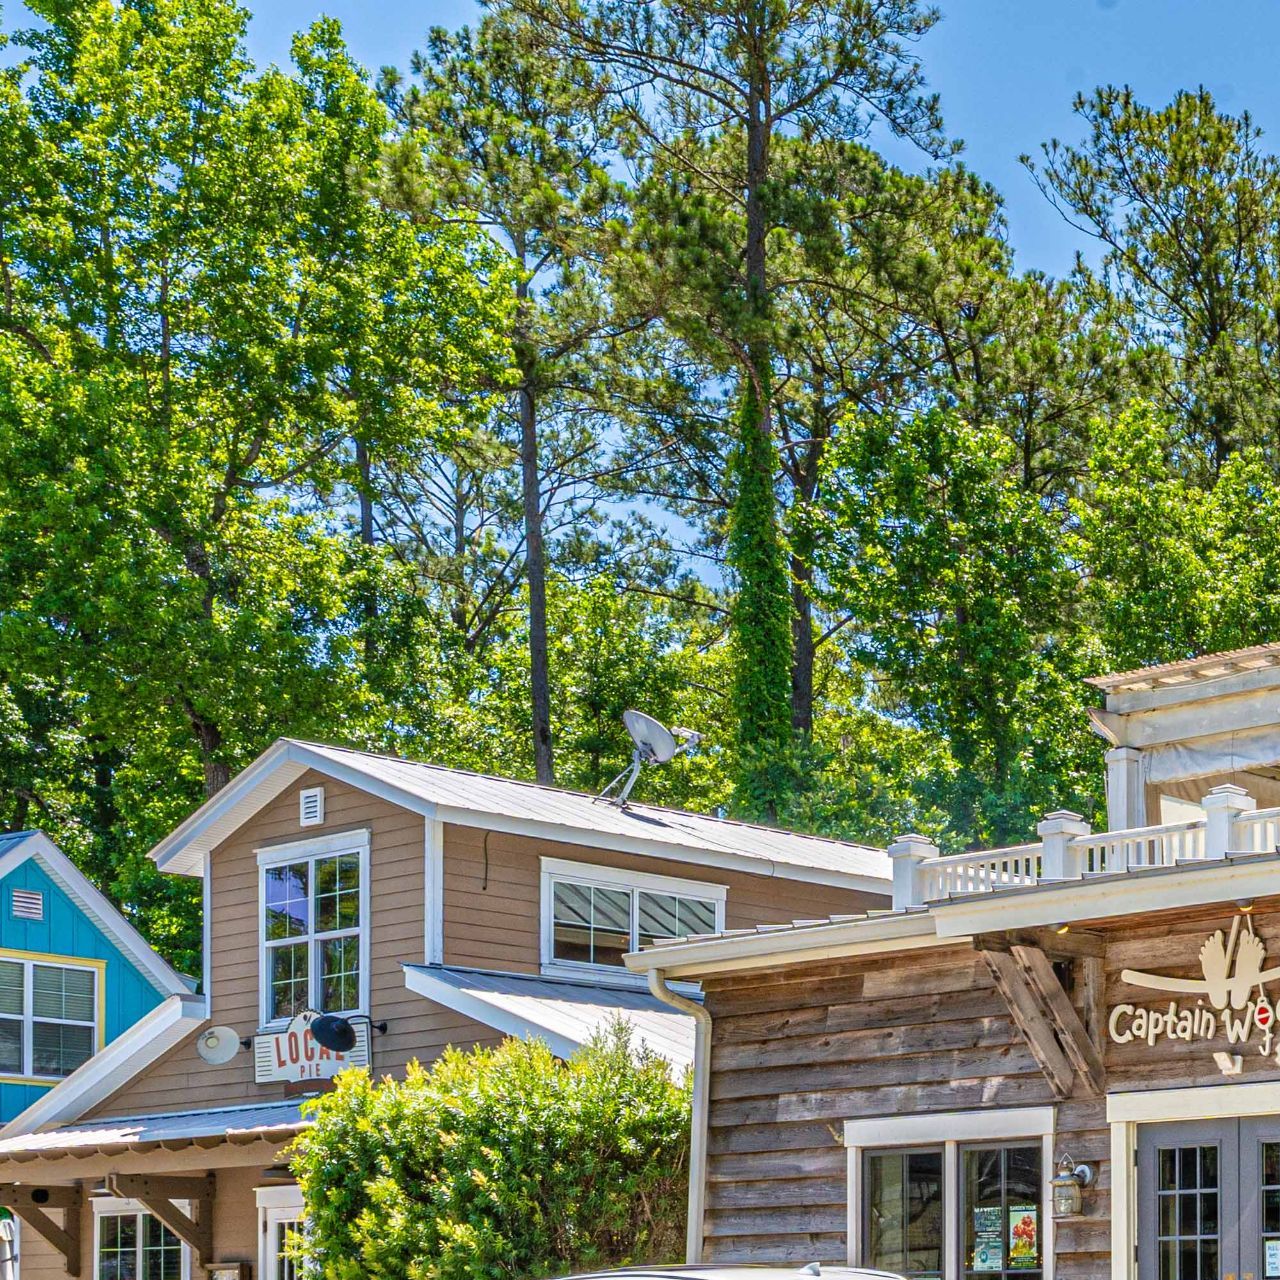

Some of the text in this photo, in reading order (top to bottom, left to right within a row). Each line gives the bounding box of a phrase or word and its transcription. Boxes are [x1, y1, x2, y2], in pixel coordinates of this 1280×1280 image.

[1109, 998, 1216, 1046] Captain
[273, 1028, 345, 1068] LOC
[300, 1063, 321, 1078] PIE
